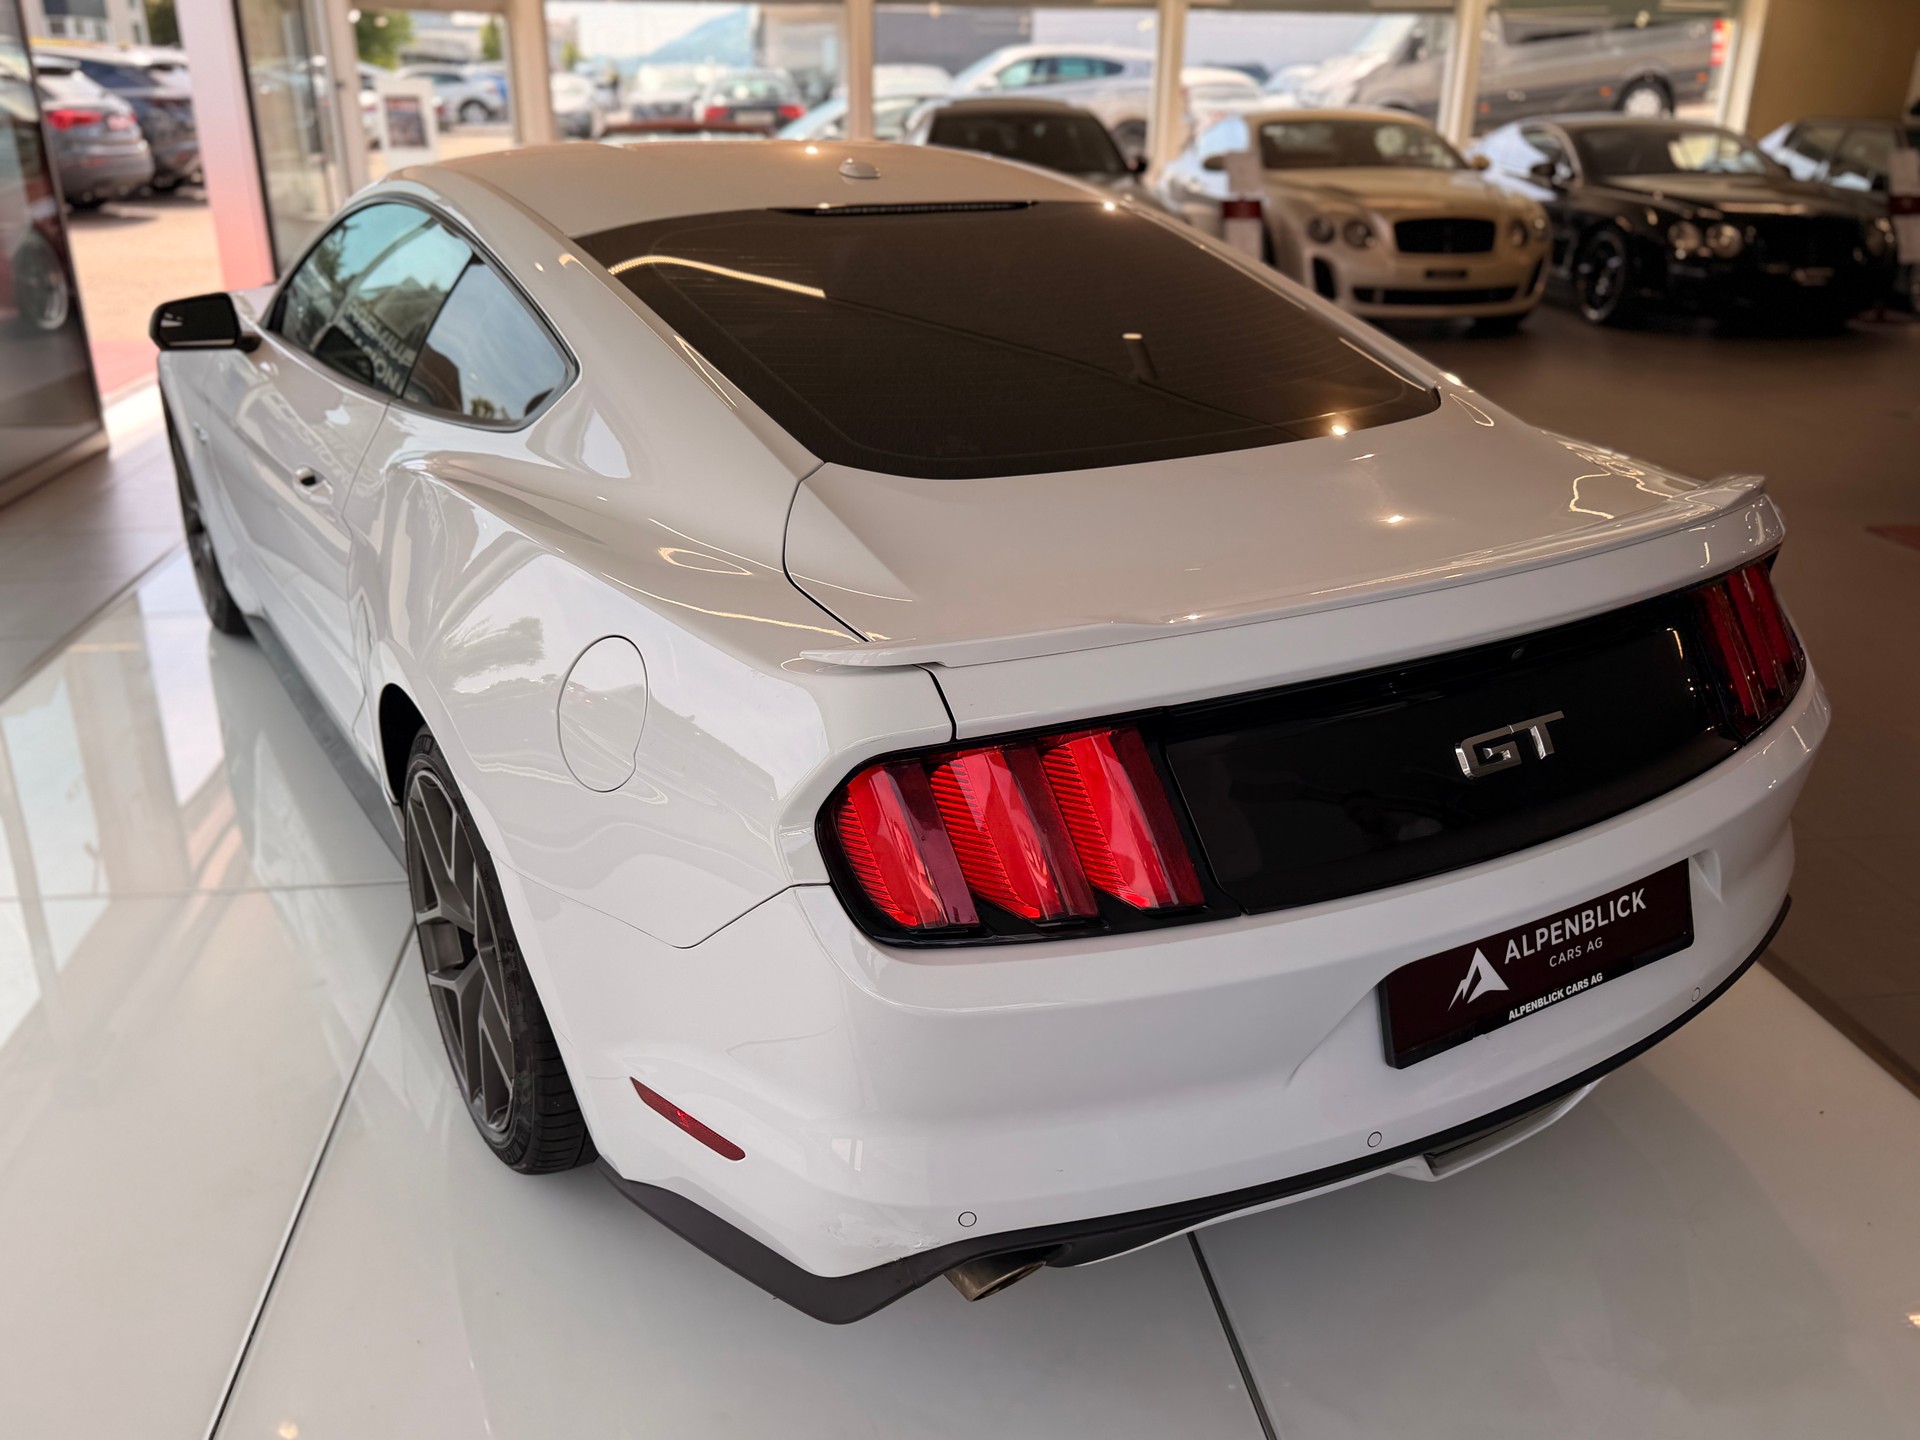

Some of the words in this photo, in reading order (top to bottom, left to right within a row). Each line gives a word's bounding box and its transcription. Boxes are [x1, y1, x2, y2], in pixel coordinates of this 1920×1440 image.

[1455, 710, 1565, 778] GT
[1504, 888, 1647, 964] ALPENBLICK
[1549, 945, 1582, 968] CARS
[1586, 936, 1603, 954] AG
[1508, 988, 1565, 1021] ALPENBLICK
[1565, 978, 1590, 996] CARS
[1590, 972, 1603, 986] AG
